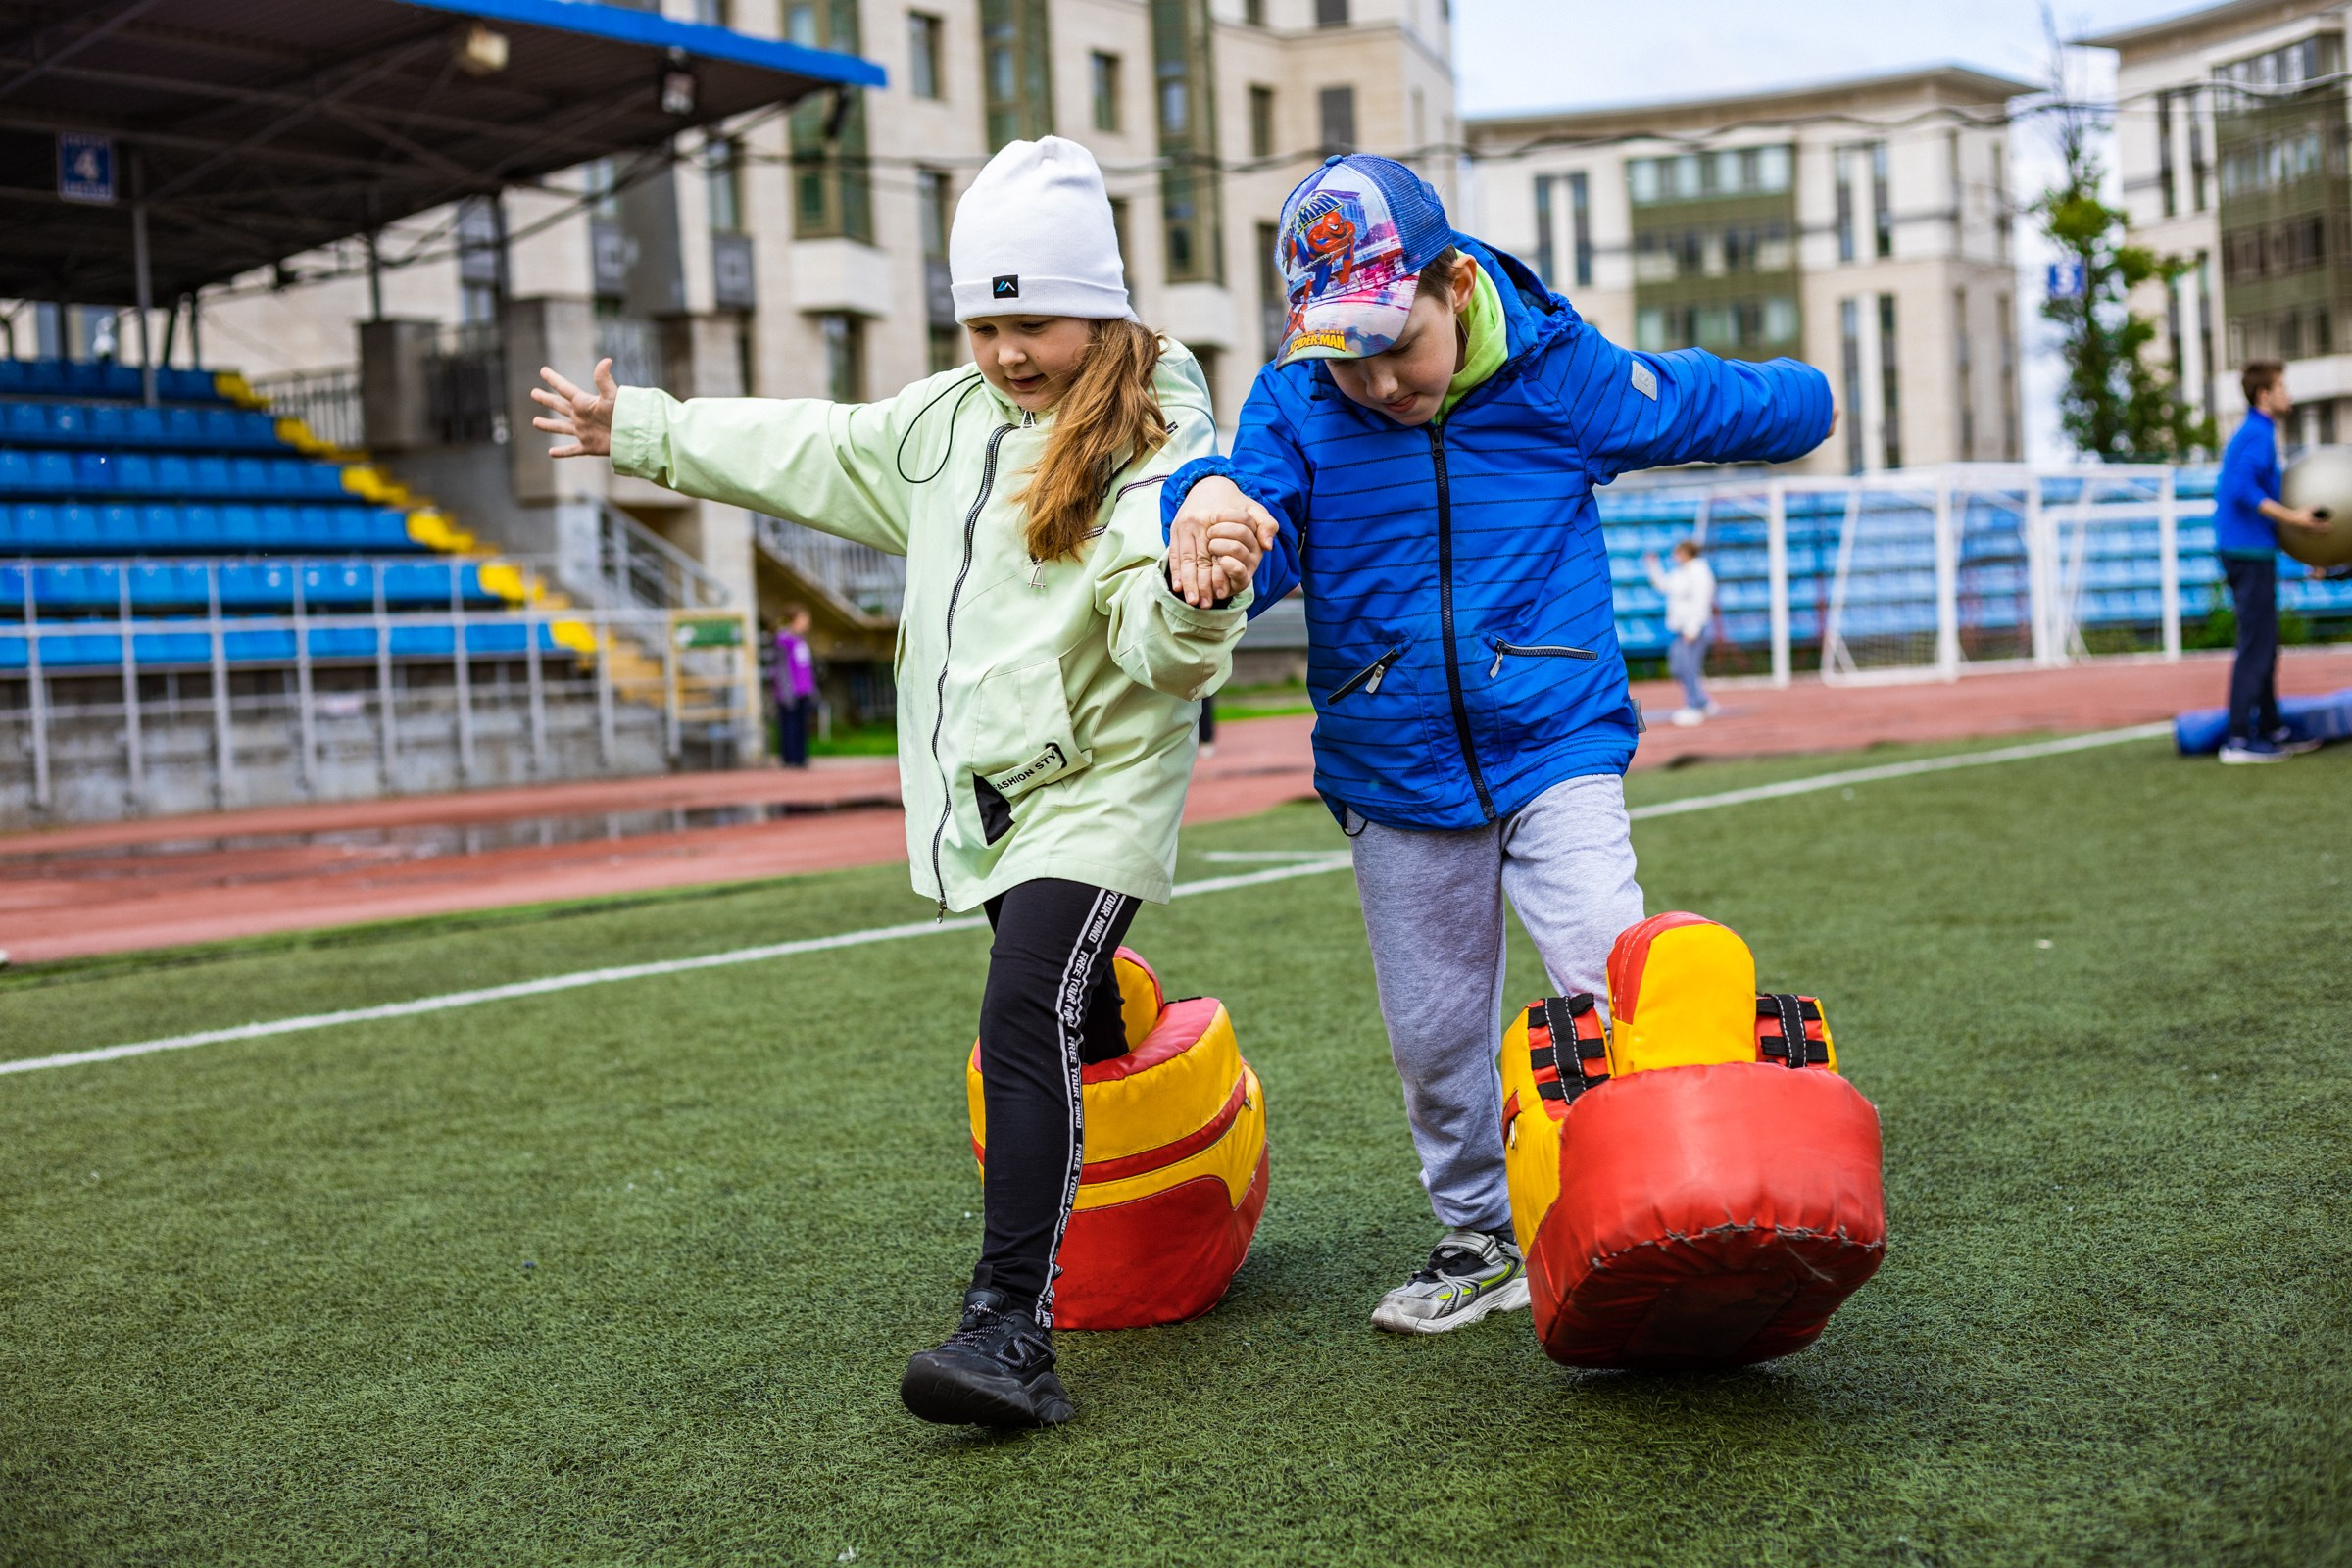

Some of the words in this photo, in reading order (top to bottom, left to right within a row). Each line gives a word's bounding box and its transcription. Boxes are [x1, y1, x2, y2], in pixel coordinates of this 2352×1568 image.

[74, 150, 99, 179] 4
[1287, 334, 1346, 356] SPIDER-MAN
[1100, 891, 1120, 918] YOUR
[1088, 915, 1106, 944] MIND
[1072, 950, 1090, 978] FREE
[1066, 978, 1082, 1005] YOUR
[1067, 1035, 1078, 1064] FREE
[1070, 1067, 1080, 1099] YOUR
[1072, 1142, 1083, 1172] FREE
[1066, 1175, 1079, 1205] YOUR
